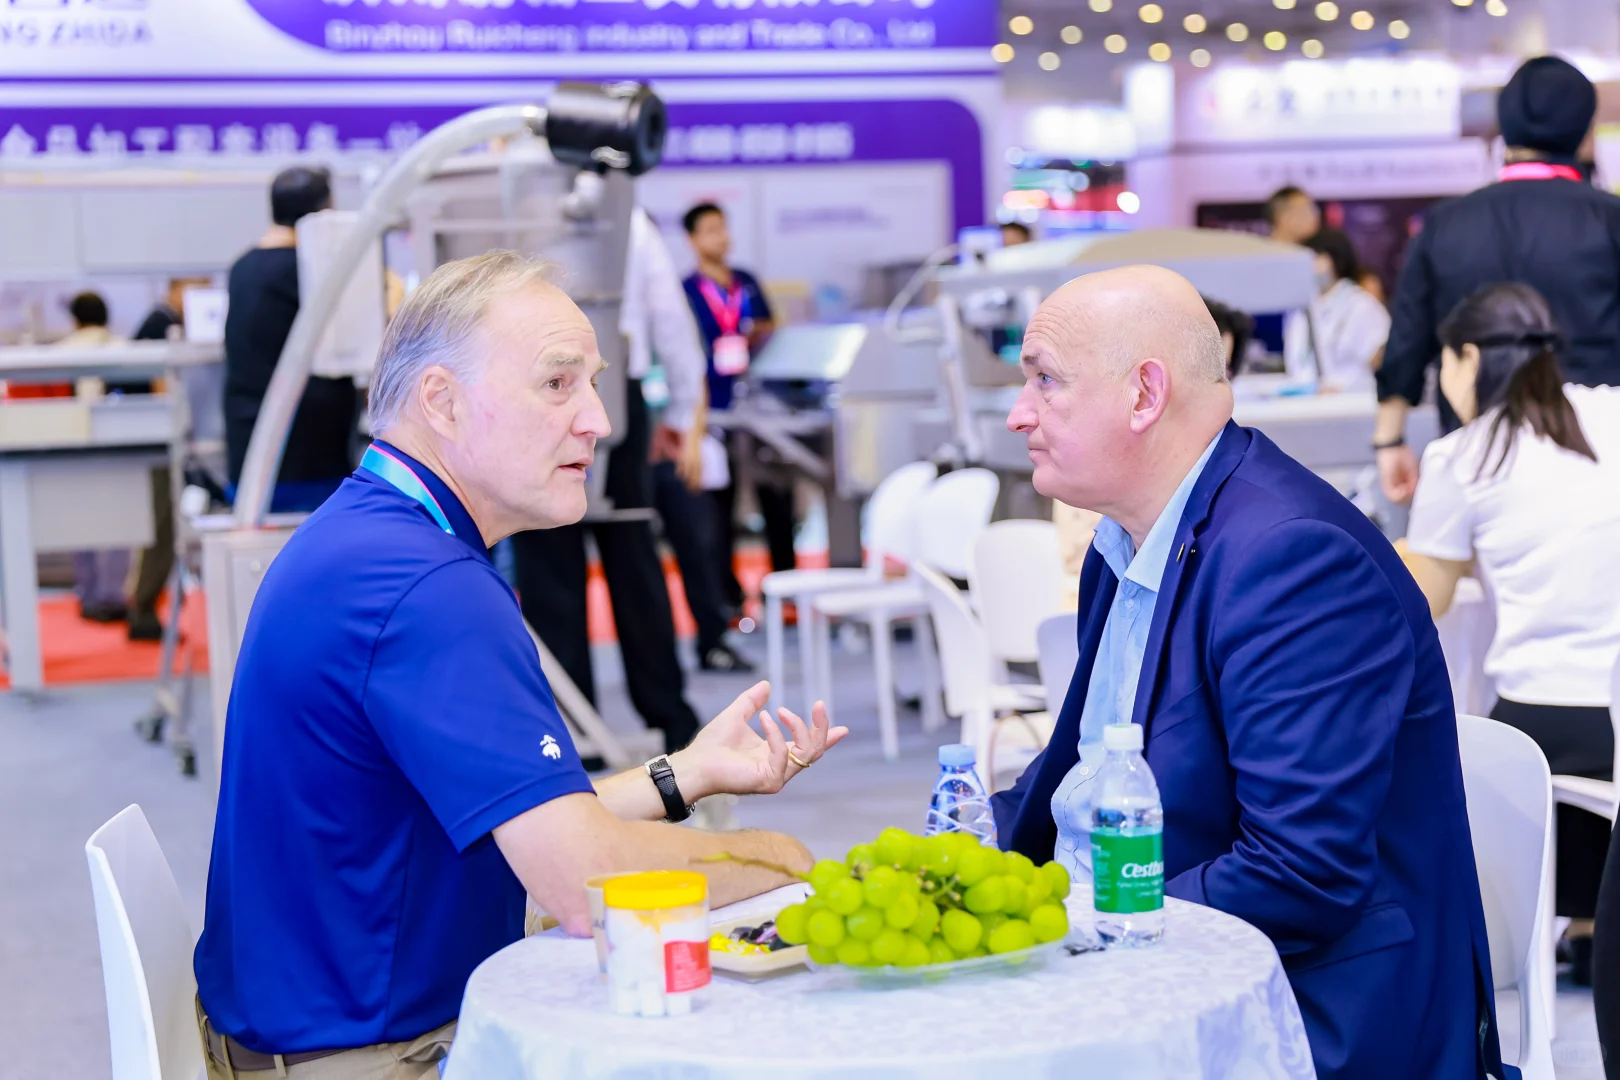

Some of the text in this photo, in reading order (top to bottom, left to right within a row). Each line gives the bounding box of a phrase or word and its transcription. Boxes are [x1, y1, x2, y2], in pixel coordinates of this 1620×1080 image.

[324, 19, 445, 50] Binzhou
[693, 21, 748, 50] and
[750, 18, 829, 50] Trade
